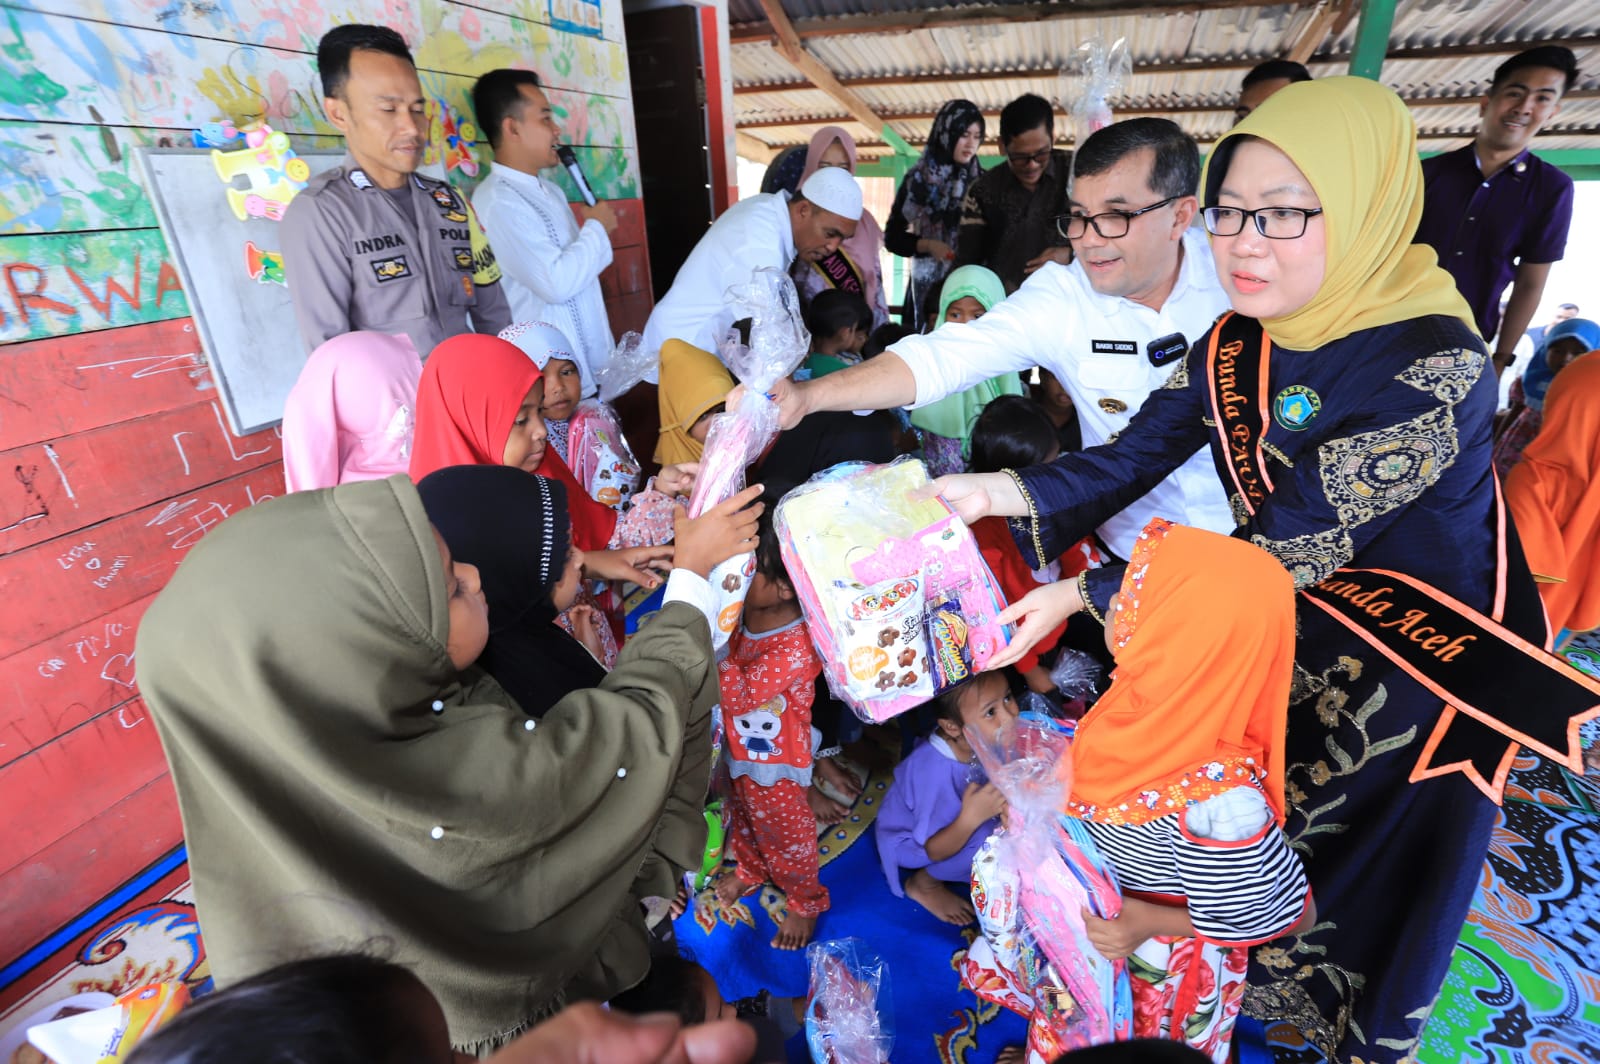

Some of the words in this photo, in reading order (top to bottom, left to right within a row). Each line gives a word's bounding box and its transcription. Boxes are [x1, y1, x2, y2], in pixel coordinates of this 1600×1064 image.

[354, 233, 406, 255] INDRA
[1218, 339, 1248, 421] Bunda
[1316, 574, 1394, 617] anda
[1379, 609, 1478, 662] Aceh
